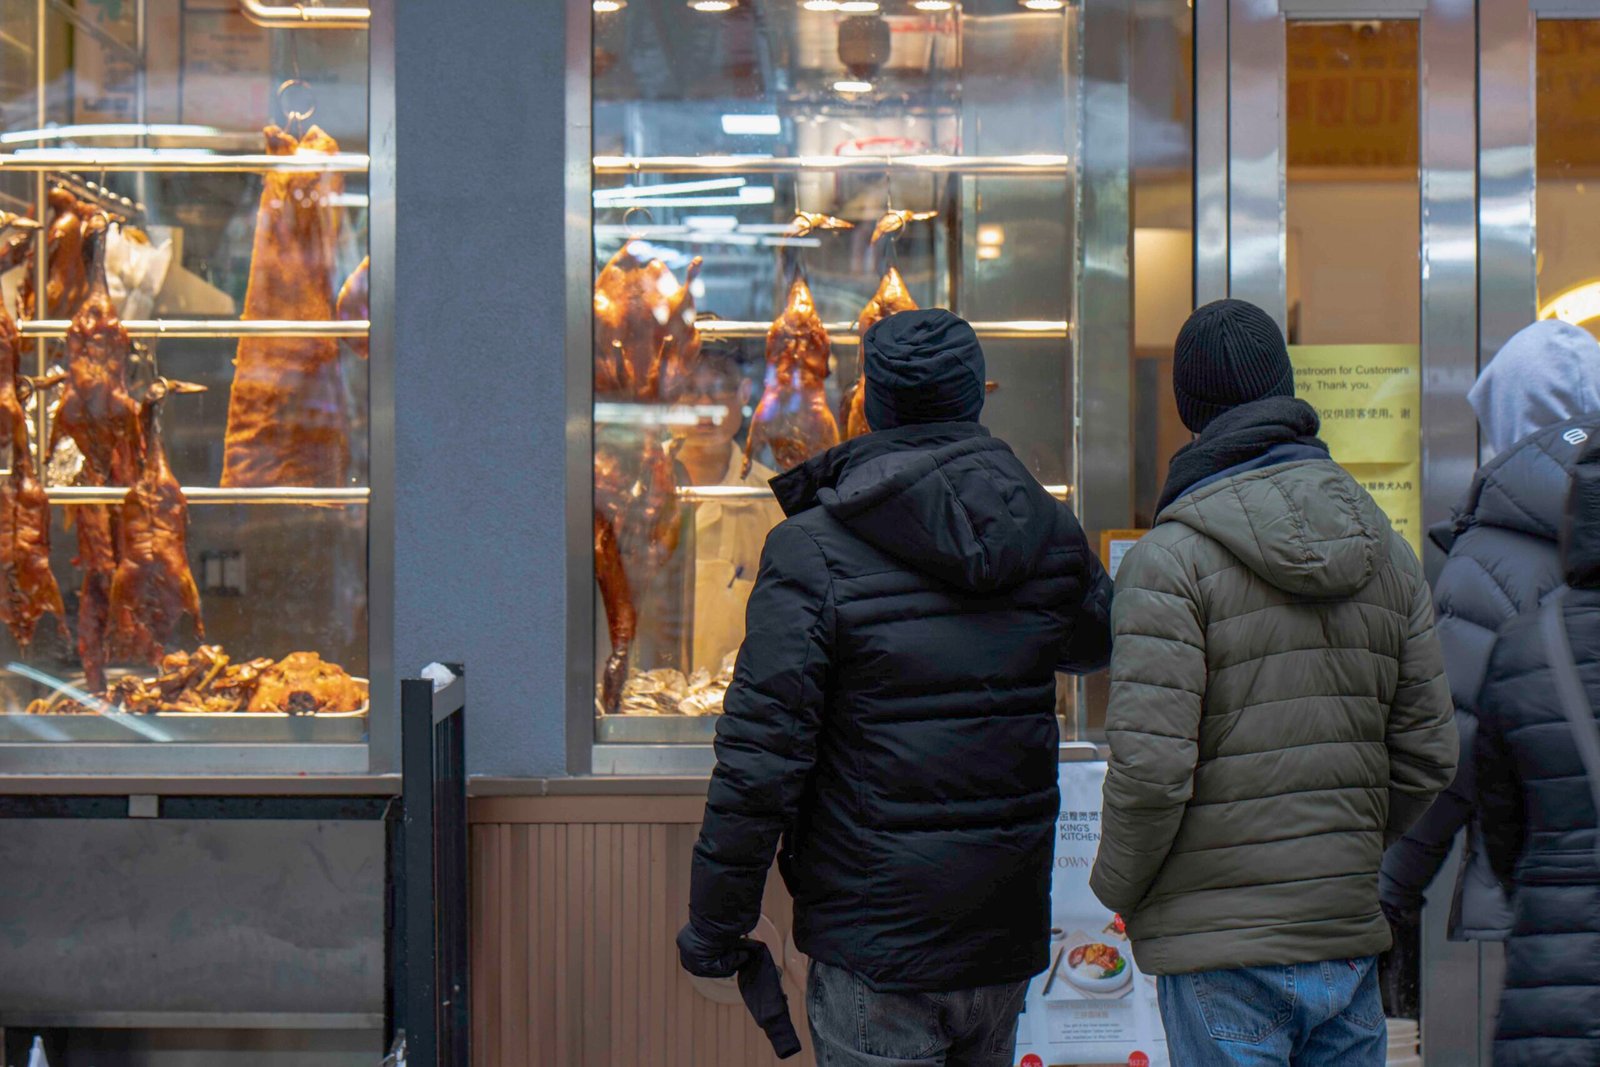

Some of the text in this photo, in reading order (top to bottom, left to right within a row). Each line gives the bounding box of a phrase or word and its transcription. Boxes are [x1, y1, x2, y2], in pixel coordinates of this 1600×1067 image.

[1294, 365, 1409, 375] estroom for Customers
[1318, 381, 1346, 390] Thank
[1060, 823, 1090, 832] KING'S
[1061, 832, 1101, 841] KITCHEN
